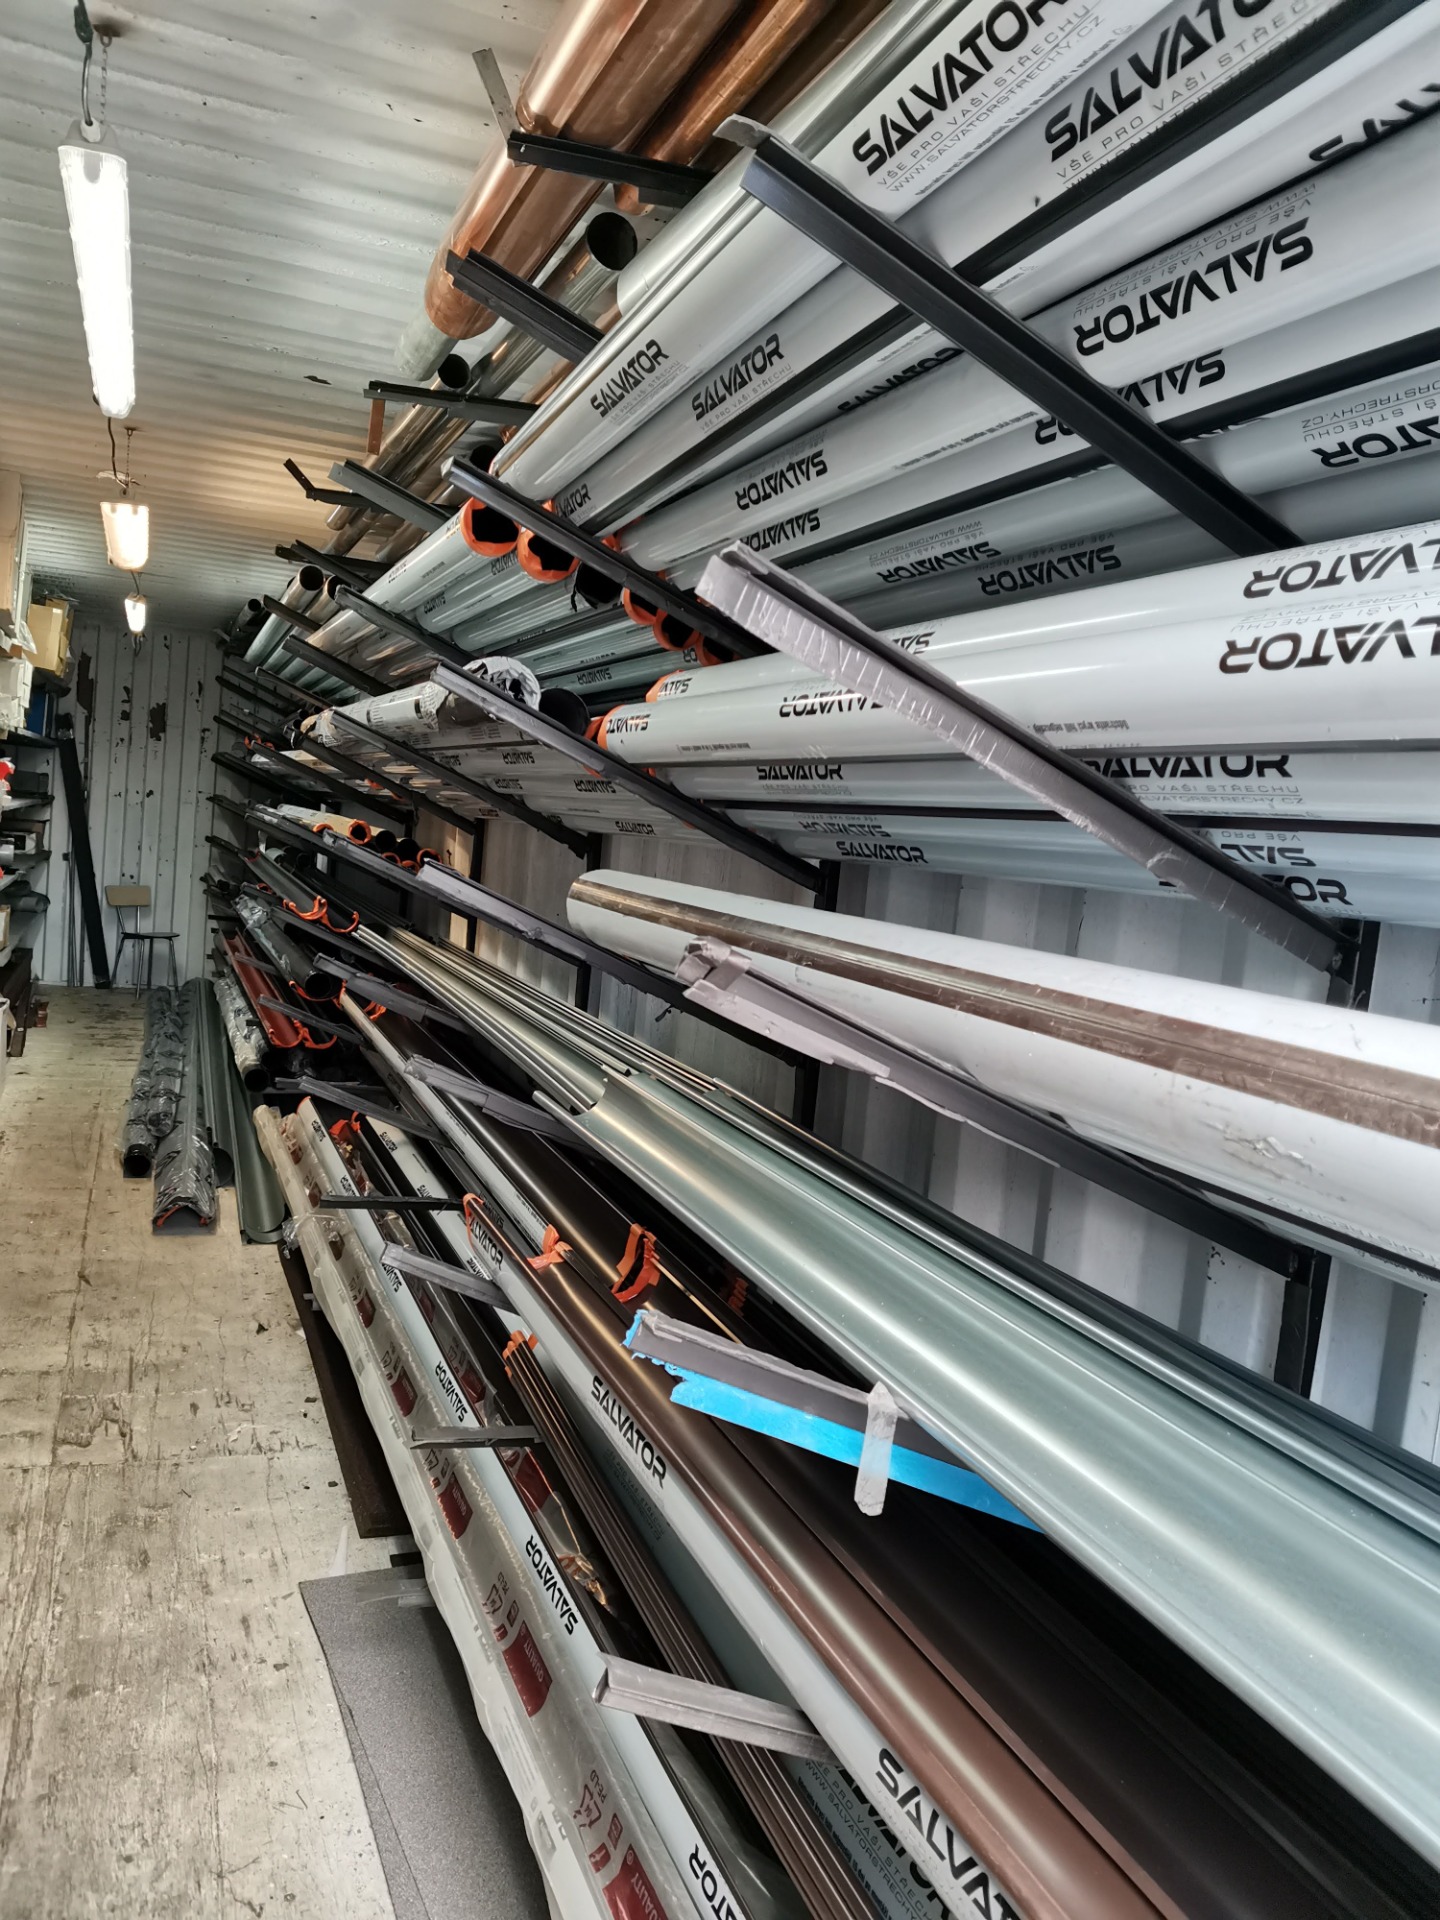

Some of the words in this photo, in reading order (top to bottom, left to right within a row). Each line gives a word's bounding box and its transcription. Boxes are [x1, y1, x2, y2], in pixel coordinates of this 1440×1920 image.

[1045, 0, 1274, 162] SALVAT
[877, 161, 908, 187] VŠE
[910, 130, 944, 159] PRO
[947, 91, 989, 127] VAŠI
[1056, 151, 1094, 179] VŠE
[1101, 115, 1144, 149] PRO
[1153, 72, 1207, 112] VAŠI
[1215, 224, 1256, 250] PRO
[1161, 250, 1205, 277] VAŠI
[1073, 217, 1313, 356] SALVATOR
[590, 339, 669, 418] SALVATOR
[691, 333, 785, 422] SALVATOR
[1303, 407, 1404, 443] STŘECHU
[735, 449, 828, 511] SALVATOR
[877, 541, 1002, 583] SALVATOR
[977, 544, 1122, 596] SALVATOR
[577, 668, 612, 685] SALVATOR
[780, 688, 884, 717] ALVATOR
[574, 779, 617, 794] SALVATOR
[1157, 782, 1198, 793] VAŠI
[1205, 783, 1299, 793] STŘECHU
[615, 820, 656, 836] SALVATOR
[799, 820, 892, 838] SALVATOR
[1221, 829, 1251, 840] PRO
[1265, 831, 1301, 842] VŠE
[836, 840, 929, 864] SALVATOR
[435, 1360, 468, 1423] SALVATOR
[591, 1375, 667, 1489] SALVATOR
[525, 1535, 579, 1635] SALVATOR
[523, 1638, 544, 1682] QUALITY
[832, 1781, 853, 1810] PRO
